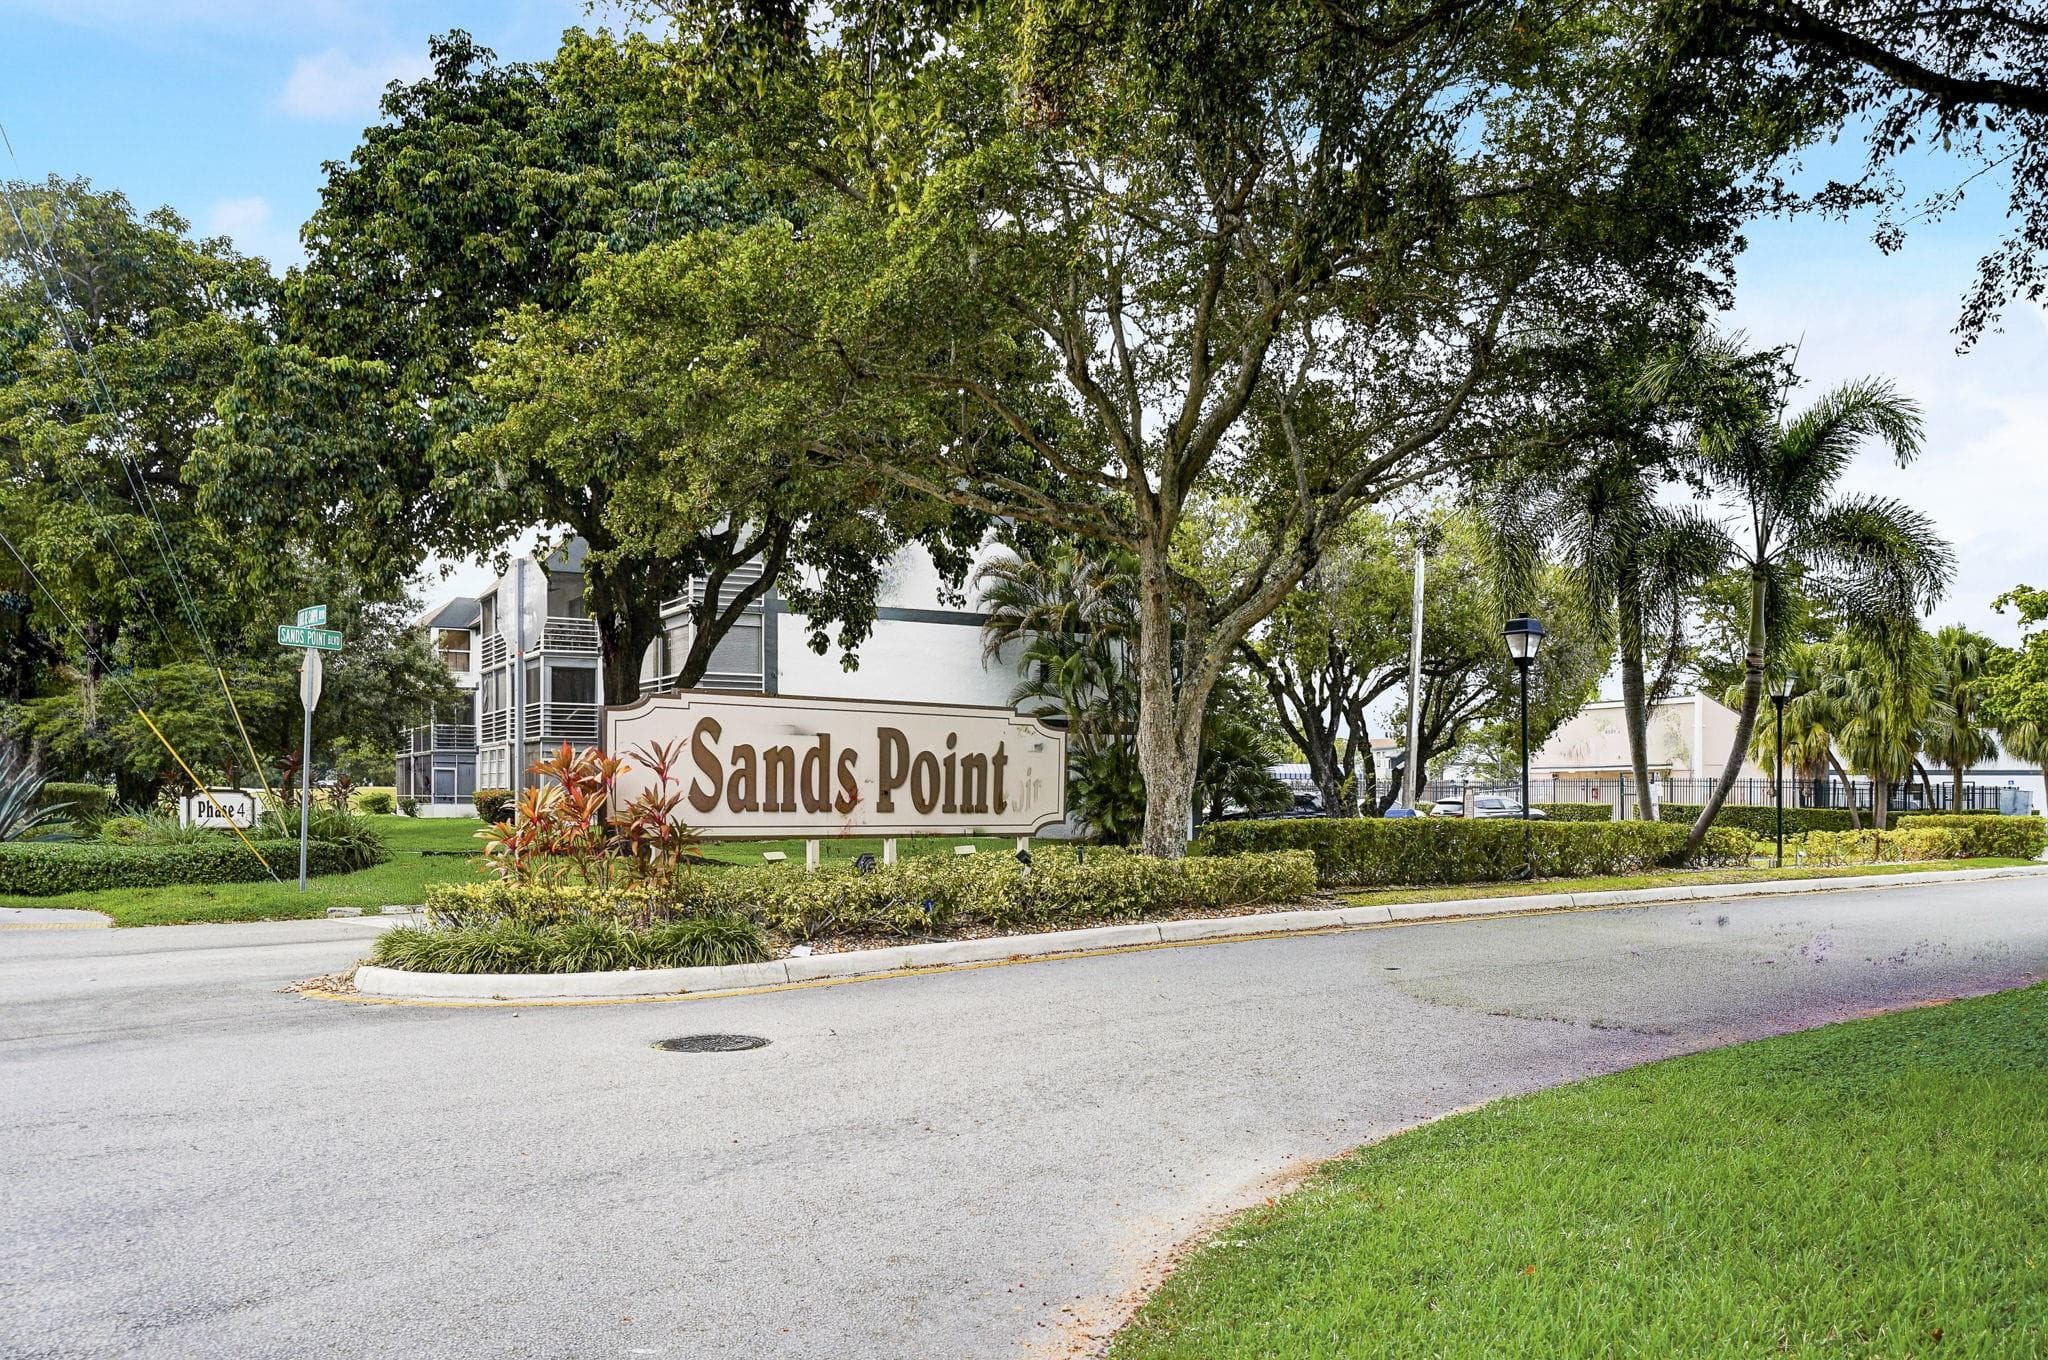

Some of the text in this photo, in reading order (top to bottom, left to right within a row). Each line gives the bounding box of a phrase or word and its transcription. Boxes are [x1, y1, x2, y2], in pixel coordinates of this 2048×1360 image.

[281, 628, 340, 646] SANDS POINT BLVD
[688, 716, 859, 814] Sands
[876, 726, 1008, 815] Point
[237, 802, 246, 818] 4
